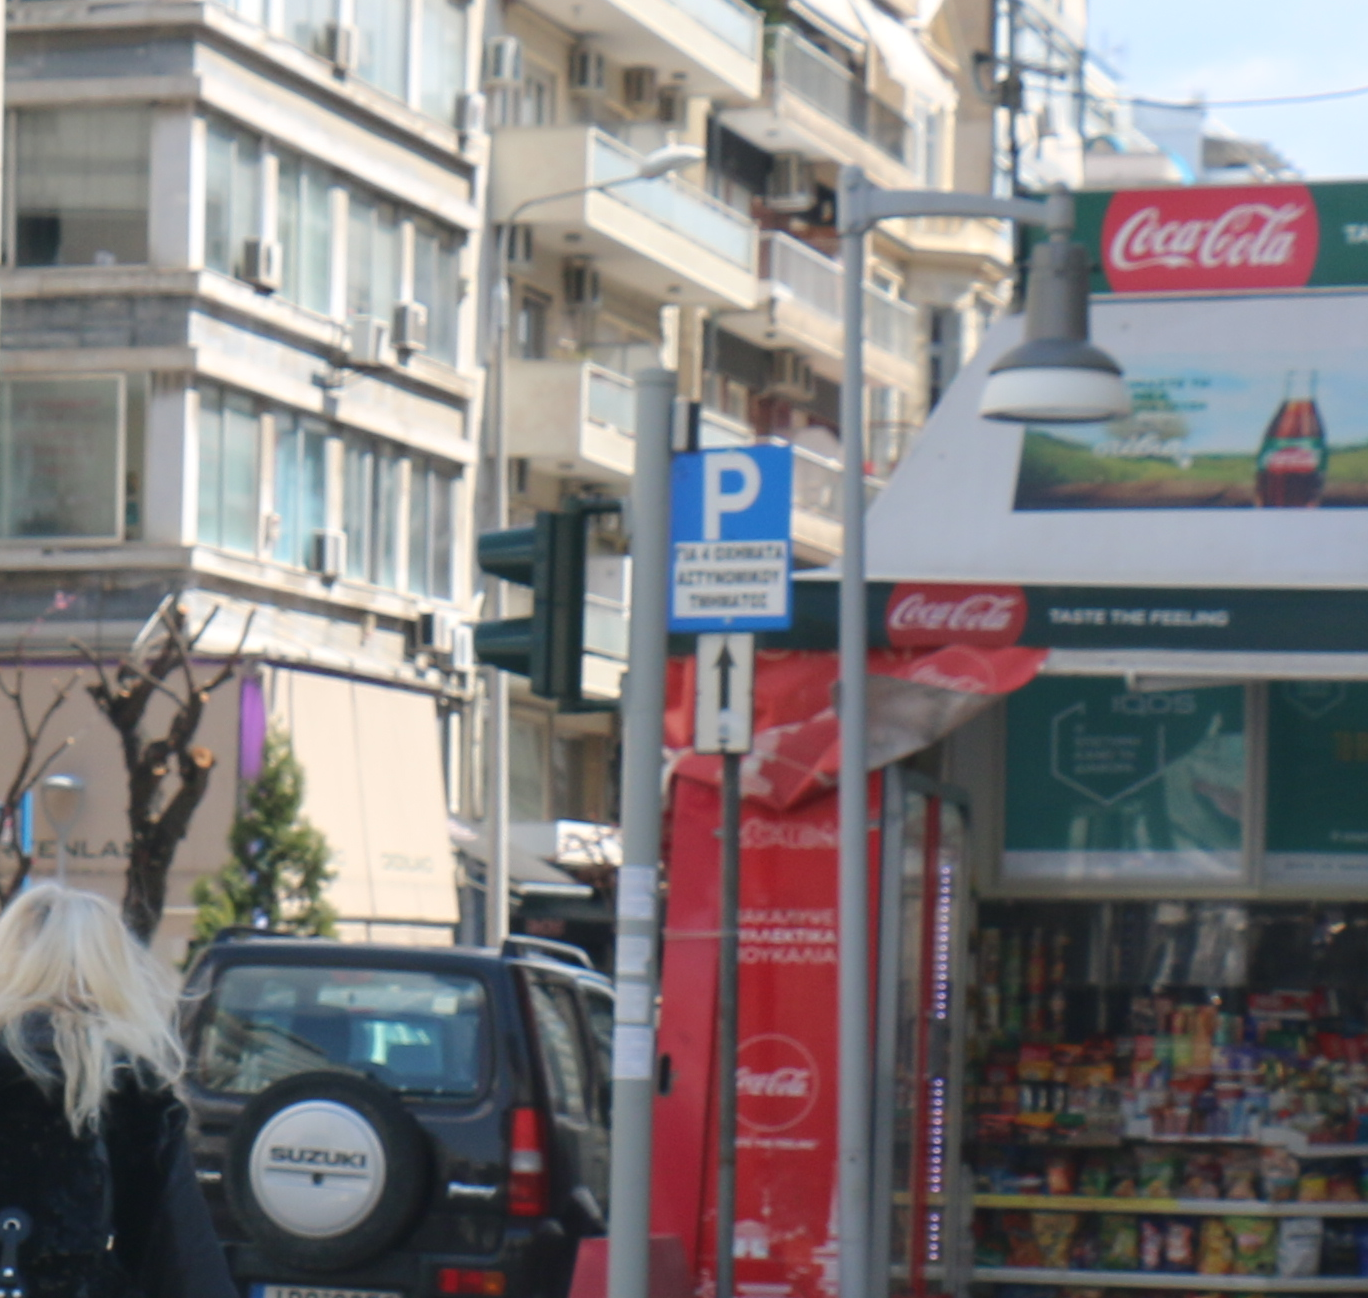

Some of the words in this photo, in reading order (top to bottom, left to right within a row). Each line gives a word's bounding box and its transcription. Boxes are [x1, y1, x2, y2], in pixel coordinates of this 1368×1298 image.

[1109, 202, 1307, 271] Coca-Cola
[704, 451, 761, 541] P
[677, 570, 780, 586] ΑΣΤΥΝΟΜΙΚΟΥ
[689, 593, 769, 609] ΤΜΗΜΑΤΟΣ
[888, 592, 1020, 632] Coca-Cola
[1049, 607, 1107, 626] TASTE
[1110, 608, 1147, 627] THE
[1149, 608, 1230, 628] FEELING
[1111, 693, 1197, 716] IQOS
[738, 908, 835, 925] ΑΚΑΛΥΨΕ
[738, 946, 837, 964] ΟΥΚΑΛΙΑ
[268, 1146, 368, 1169] SUZUKI
